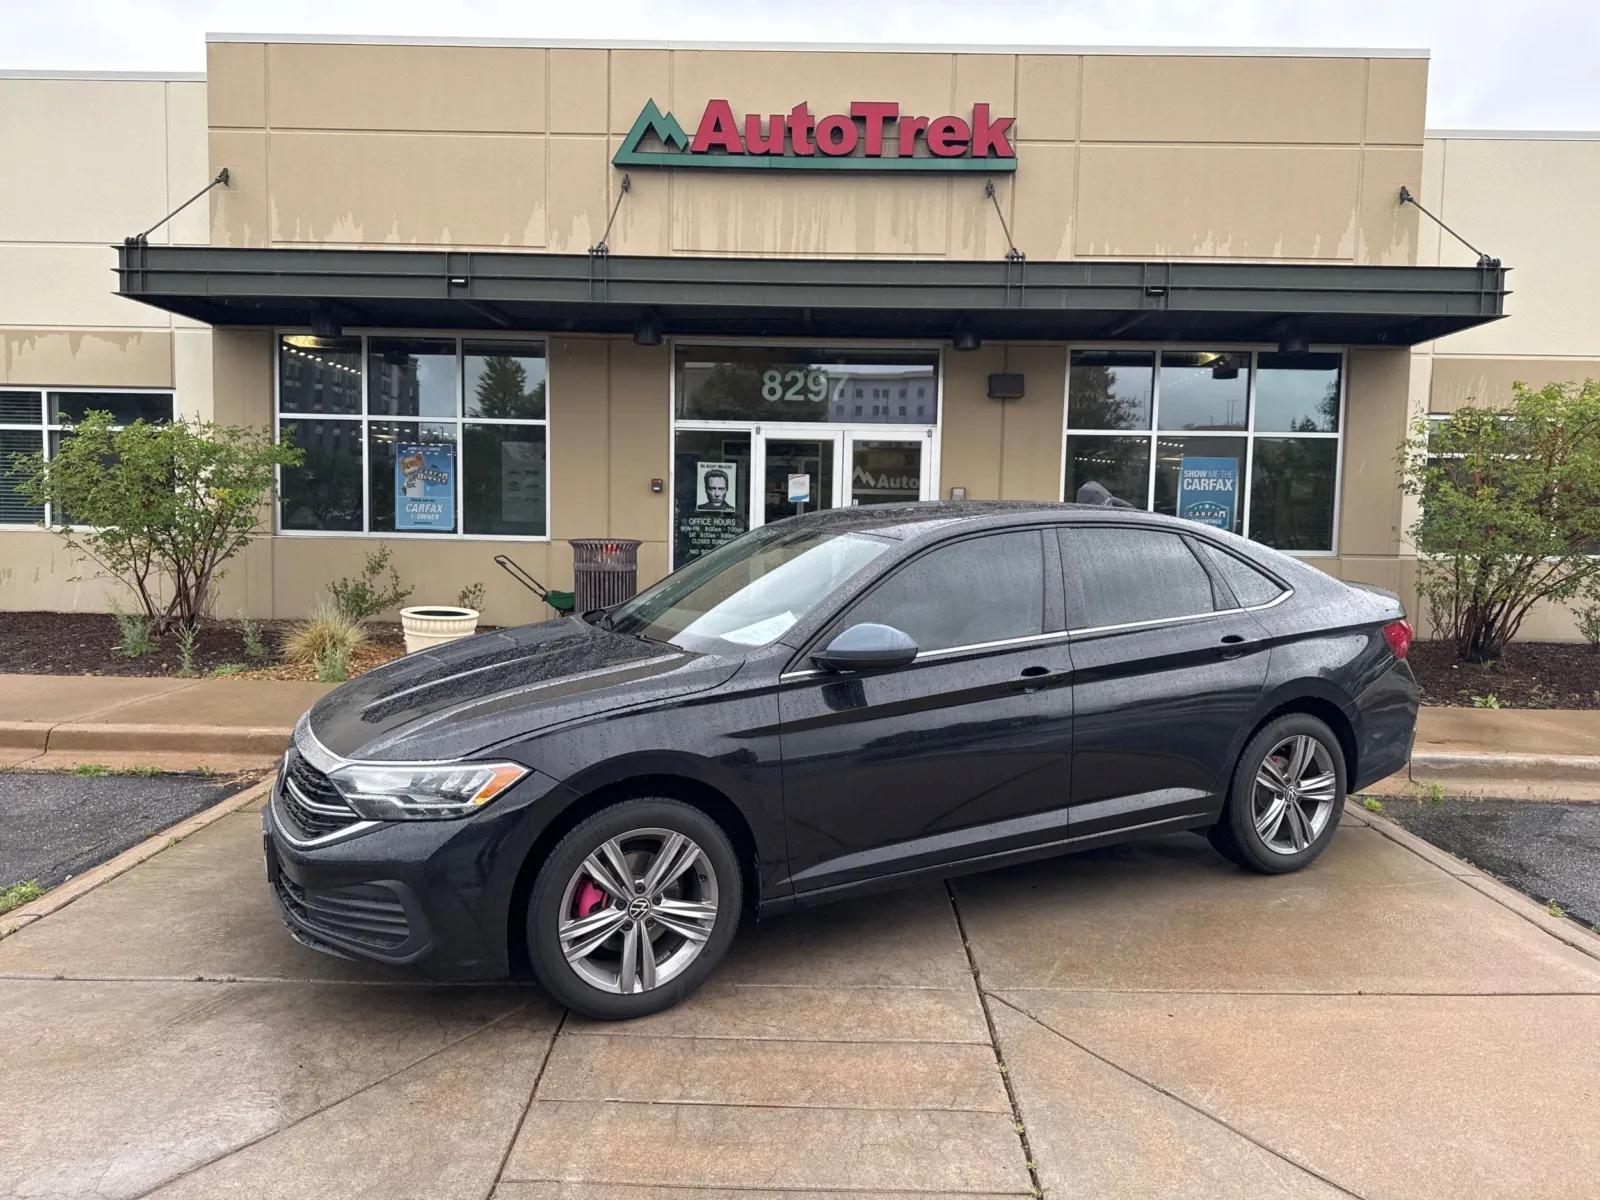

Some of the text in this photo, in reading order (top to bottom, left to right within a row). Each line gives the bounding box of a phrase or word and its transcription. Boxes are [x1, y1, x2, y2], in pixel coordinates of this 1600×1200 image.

[691, 99, 1016, 158] AutoTrek
[762, 370, 848, 401] 8297
[1183, 470, 1207, 478] SHOW
[1208, 470, 1219, 478] ME
[1183, 478, 1233, 491] CARFAX
[405, 503, 443, 513] CARFAX
[688, 518, 736, 526] OFFICE HOURS
